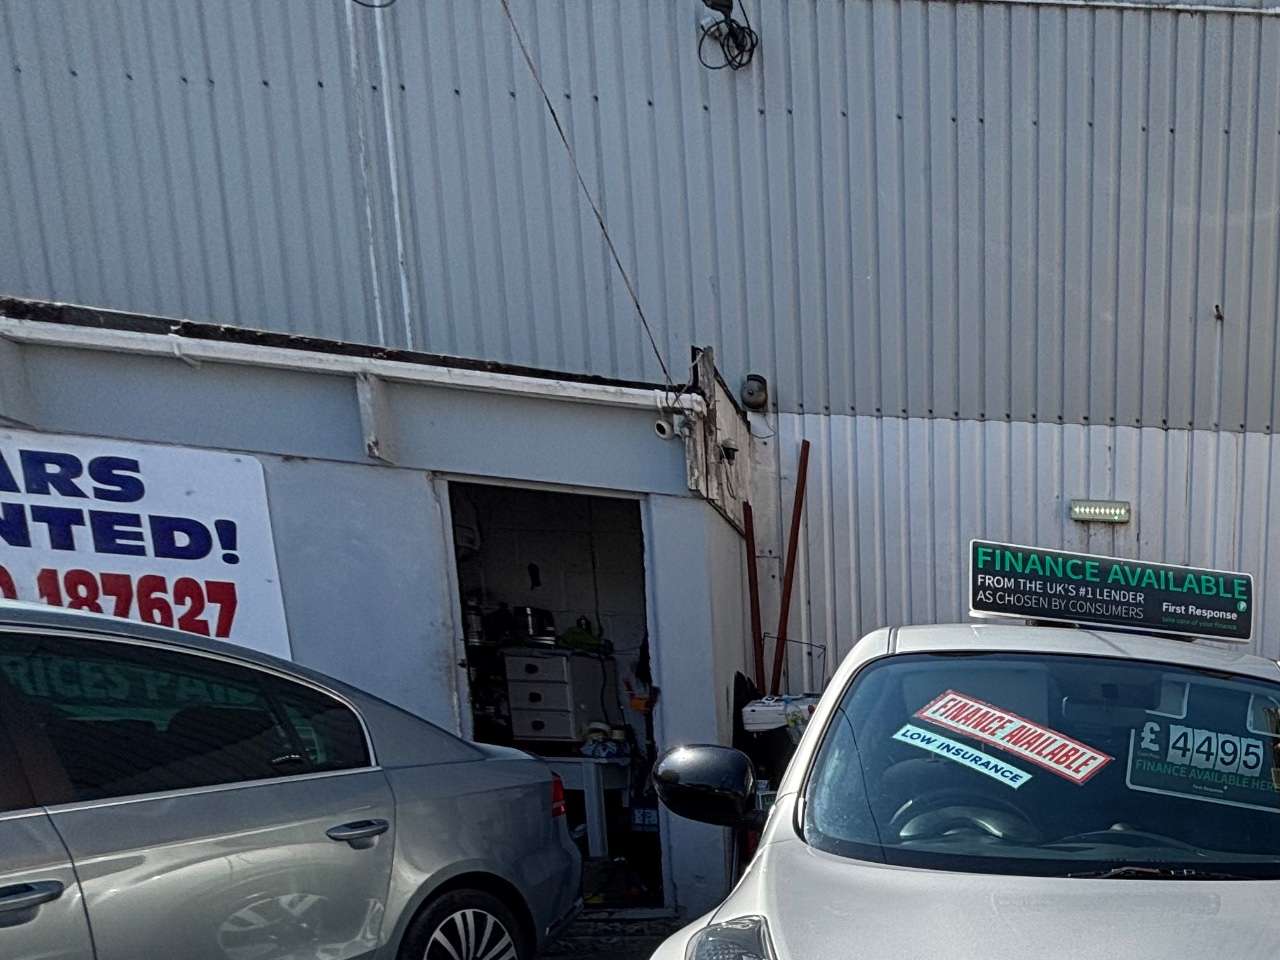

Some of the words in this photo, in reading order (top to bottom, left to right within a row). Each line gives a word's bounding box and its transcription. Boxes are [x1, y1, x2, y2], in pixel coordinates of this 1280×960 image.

[977, 547, 1100, 582] FINANCE
[1107, 564, 1248, 600] AVAILABLE
[977, 574, 1015, 589] FROM
[1018, 578, 1044, 593] THE
[1047, 582, 1076, 597] UK'S
[1079, 587, 1093, 599] #1
[1096, 588, 1145, 604] LENDER
[976, 590, 993, 603] AS
[996, 591, 1048, 609] CHOSEN
[1052, 598, 1067, 611] BY
[1069, 600, 1144, 619] CONSUMERS
[1162, 602, 1186, 615] First
[1188, 605, 1238, 621] Response
[931, 697, 1009, 737] FINANCE
[1003, 724, 1098, 775] AVAILABLE
[1170, 729, 1262, 771] 4495
[901, 729, 938, 745] LOW
[937, 742, 1024, 783] INSURANCE
[1135, 759, 1188, 777] FINANCE
[1190, 768, 1249, 788] AVAILABLE
